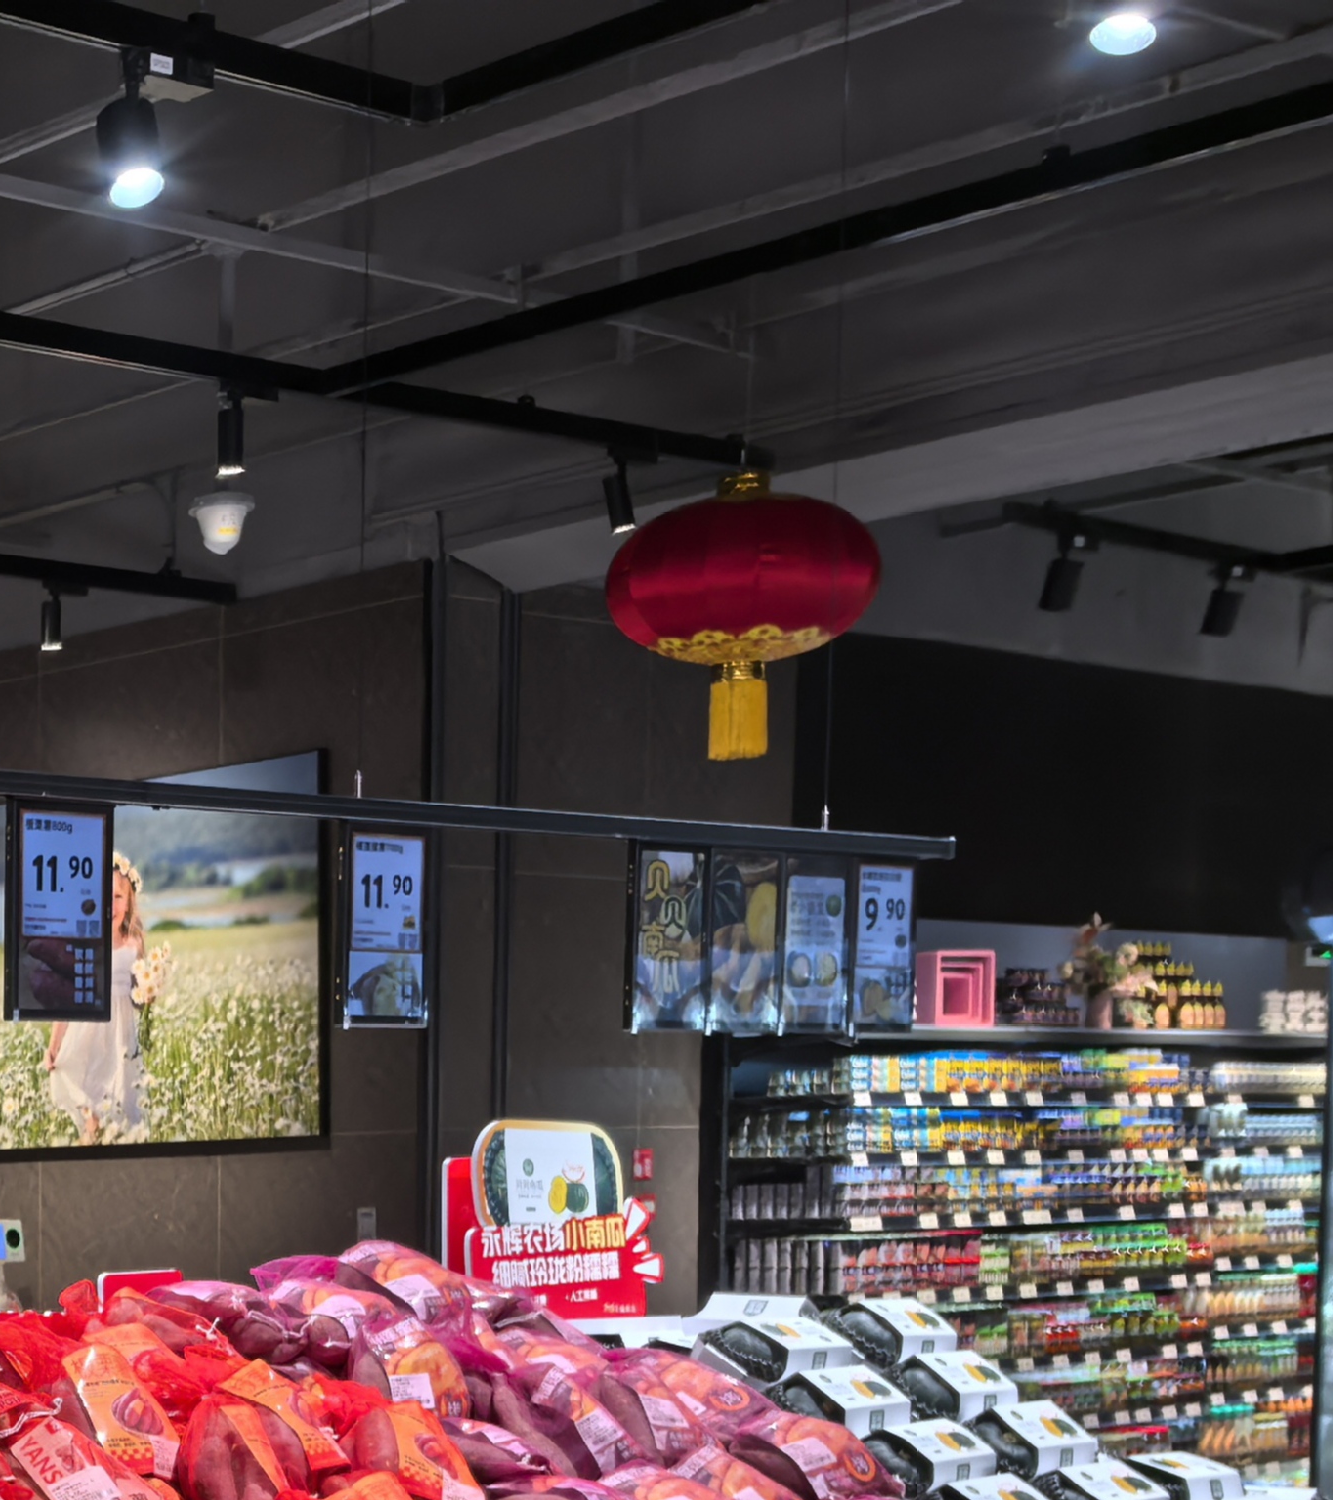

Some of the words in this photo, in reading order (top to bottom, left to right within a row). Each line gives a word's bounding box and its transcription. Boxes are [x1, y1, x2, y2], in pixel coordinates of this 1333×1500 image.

[481, 1217, 626, 1259] 永辉农场小南瓜
